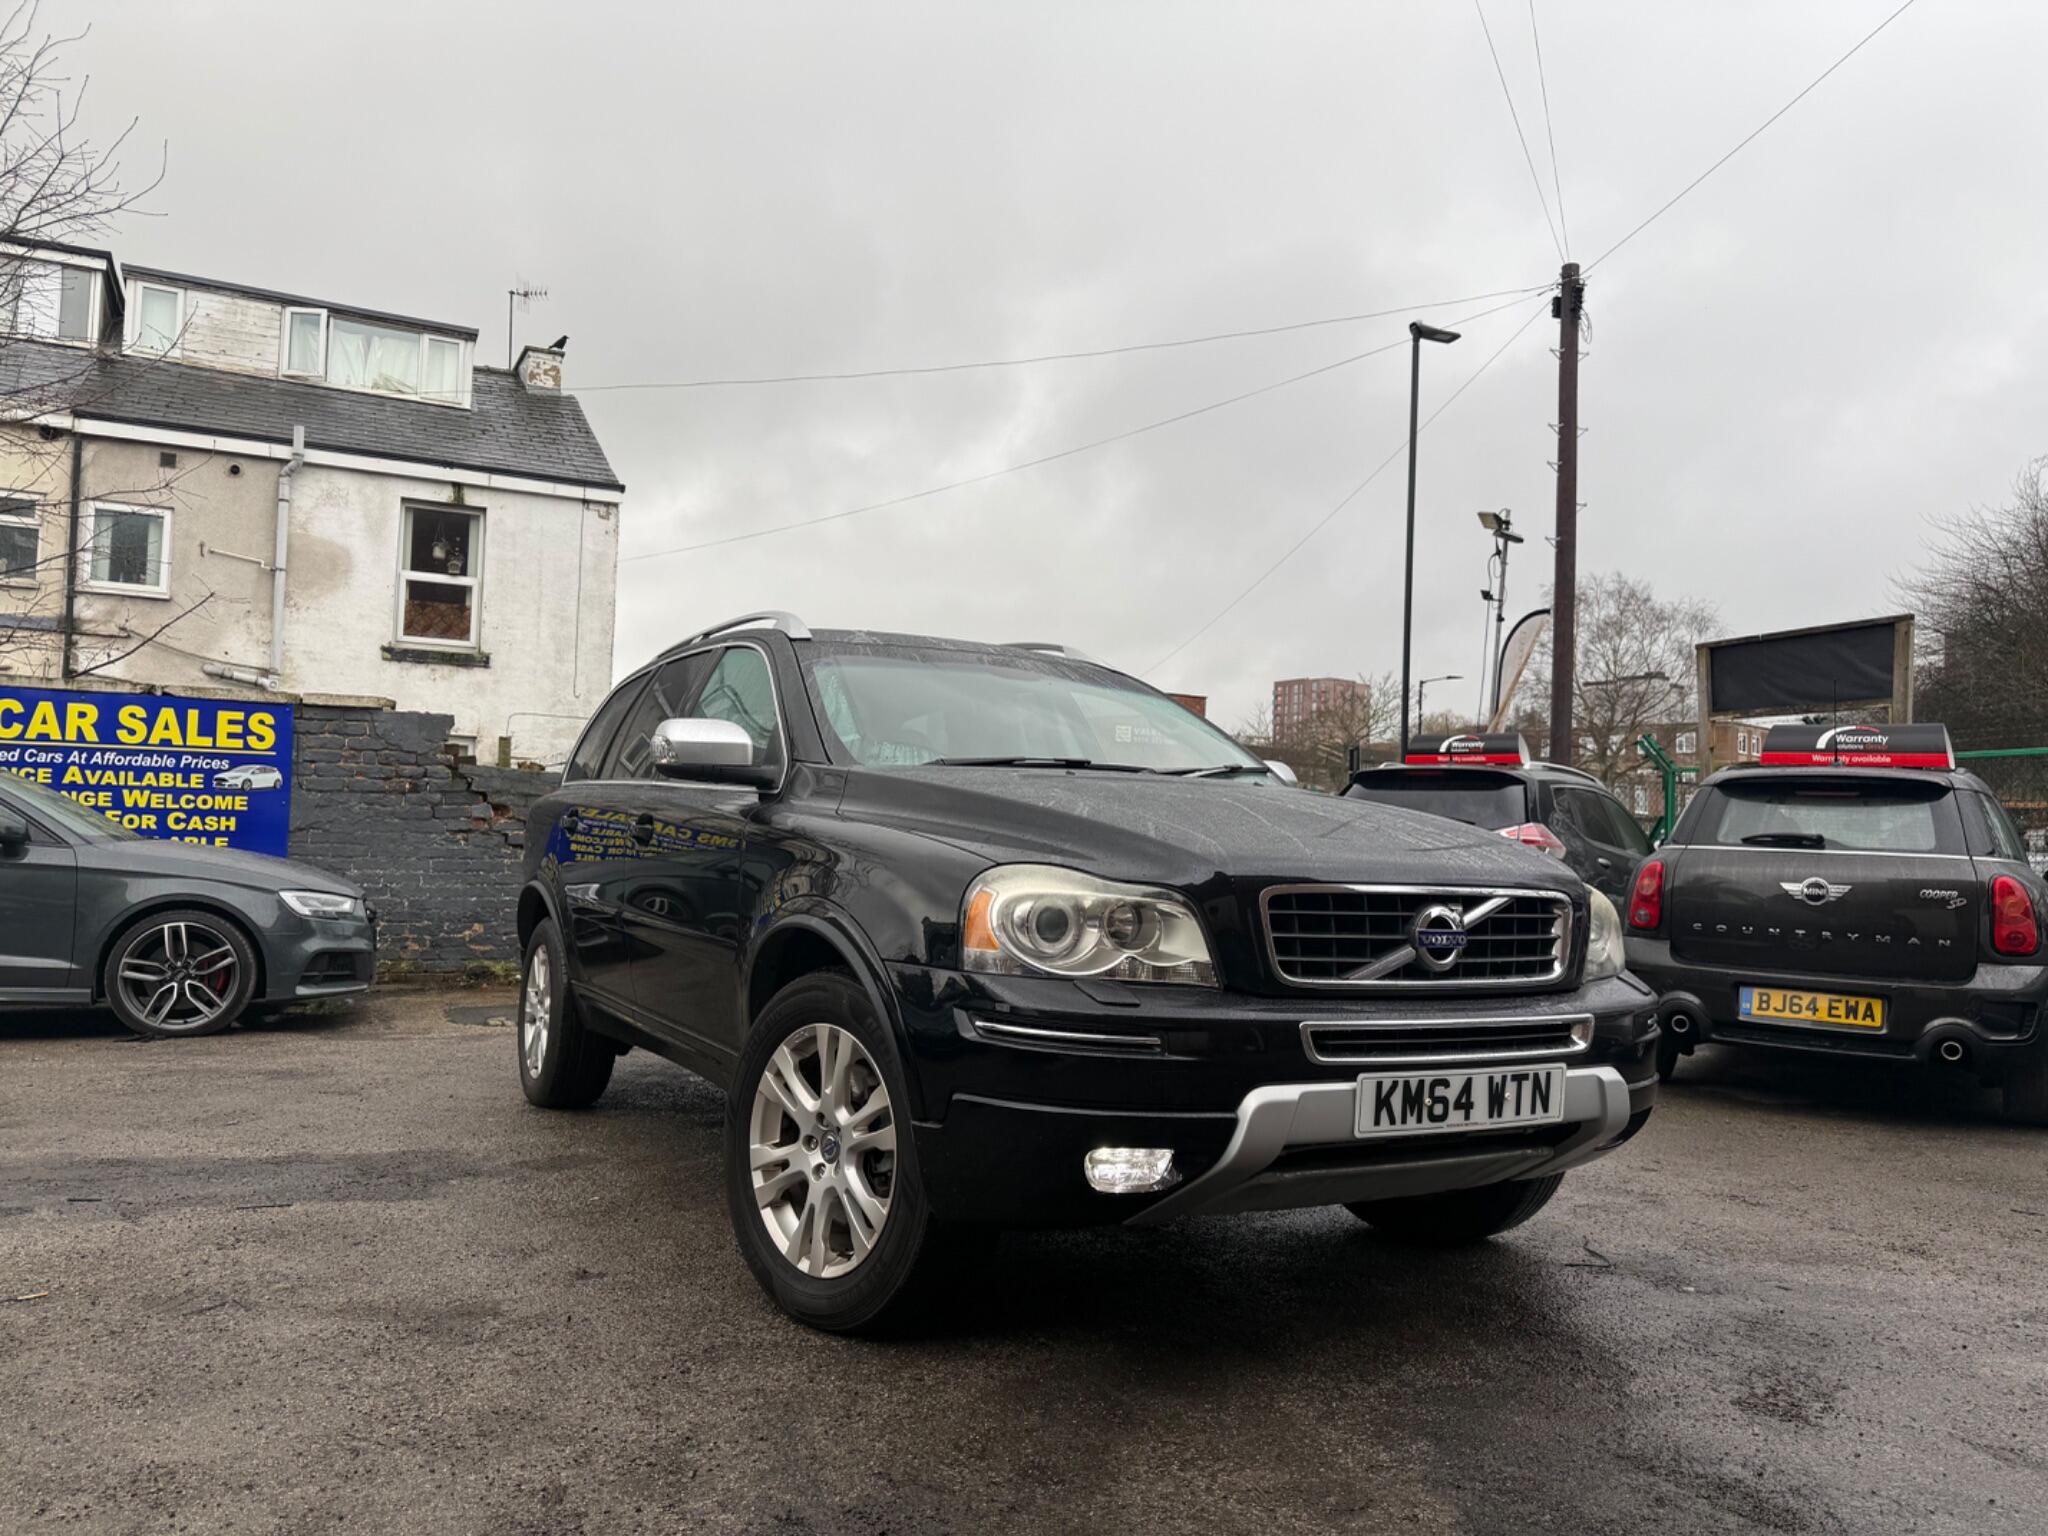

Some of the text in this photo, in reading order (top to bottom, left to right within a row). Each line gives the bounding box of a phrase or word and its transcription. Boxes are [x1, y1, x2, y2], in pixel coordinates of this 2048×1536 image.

[0, 698, 277, 750] CAR SALES
[1835, 734, 1888, 745] Warranty
[23, 748, 64, 764] Cars
[66, 750, 89, 766] At
[89, 751, 176, 769] Affordable
[179, 754, 231, 770] Prices
[1812, 754, 1849, 764] Warrnty
[61, 764, 205, 789] AVAILABLE
[121, 788, 249, 811] WELCOME
[166, 811, 237, 832] CASH
[1804, 886, 1827, 897] MINI
[1919, 888, 1959, 900] COOPER
[1421, 934, 1467, 945] VOLVO
[1693, 923, 1950, 946] COUNTRYMAN
[1756, 991, 1876, 1022] BJ64 EWA
[1373, 1071, 1551, 1127] KM64 WTN
